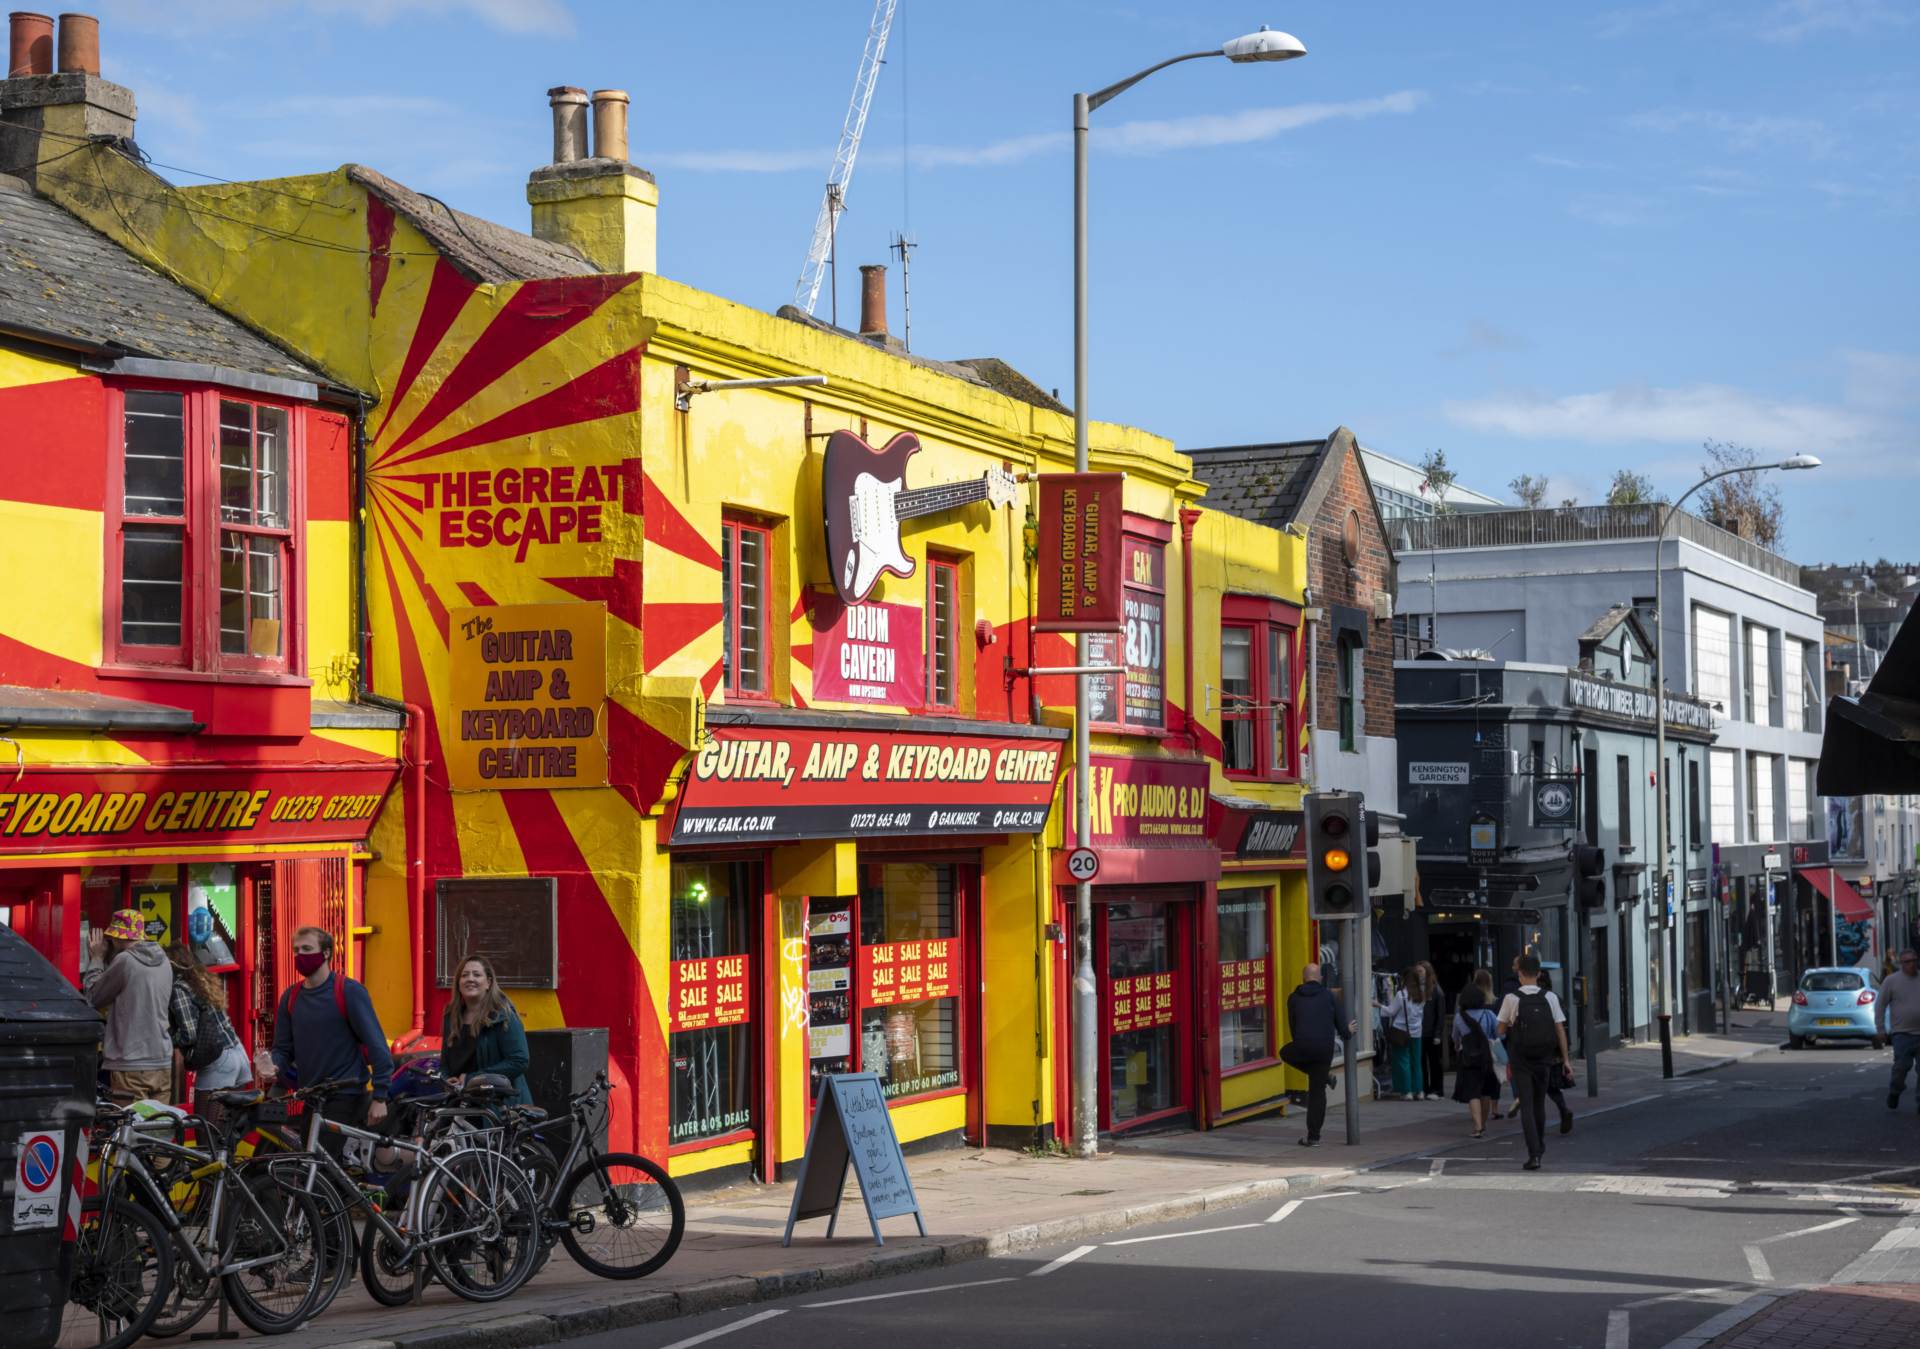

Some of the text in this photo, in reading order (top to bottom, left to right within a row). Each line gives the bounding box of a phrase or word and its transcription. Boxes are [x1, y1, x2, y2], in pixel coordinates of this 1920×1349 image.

[440, 505, 602, 563] ESCAPE
[1081, 503, 1099, 557] GUITAR,
[1060, 488, 1077, 617] KEYBOARD CENTRE
[1082, 559, 1097, 592] AMP
[1133, 550, 1152, 585] GAK
[1082, 594, 1097, 608] &
[1125, 599, 1160, 623] PRO AUDIO
[461, 615, 493, 641] The
[847, 604, 888, 643] DRUM
[481, 629, 573, 663] GUITAR
[841, 642, 895, 683] CAVERN
[485, 668, 570, 702] AMP &
[1592, 683, 1609, 711] ROAD
[1609, 687, 1635, 719] TIMBER,
[461, 707, 594, 741] KEYBOARD
[479, 746, 577, 780] CENTRE
[696, 740, 1057, 787] GUITAR, AMP & KEYBOARD CENTRE
[1412, 765, 1467, 774] KENSINGTON
[1418, 774, 1460, 782] GARDENS
[144, 789, 271, 834] CENTRE
[270, 795, 323, 821] 01273
[322, 794, 382, 820] 672977
[1113, 783, 1137, 817] PRO
[1140, 784, 1175, 818] AUDIO
[1178, 786, 1188, 818] &
[1191, 787, 1205, 818] DJ
[683, 811, 1044, 833] WWW.GAK.CO.UK 01273 665 400 GAKMUSIC GAK_CO_UK
[1072, 857, 1095, 872] 20
[829, 913, 848, 923] 0%
[873, 941, 947, 964] SALE SALE SALE
[680, 958, 742, 983] SALE SALE
[873, 962, 947, 987] SALE SALE SALE
[1222, 959, 1265, 979] SALE SALE SALE
[680, 983, 743, 1008] SALE SALE
[1114, 974, 1171, 996] SALE SALE SALE
[1222, 977, 1265, 997] SALE SALE SALE
[1114, 993, 1172, 1016] SALE SALE SALE
[901, 1081, 910, 1093] UP
[911, 1079, 920, 1091] TO
[921, 1076, 930, 1088] 60
[931, 1071, 958, 1087] MONTHS
[673, 1120, 698, 1138] LATER
[701, 1118, 707, 1132] &
[709, 1115, 722, 1130] 0%
[724, 1109, 750, 1126] DEALS
